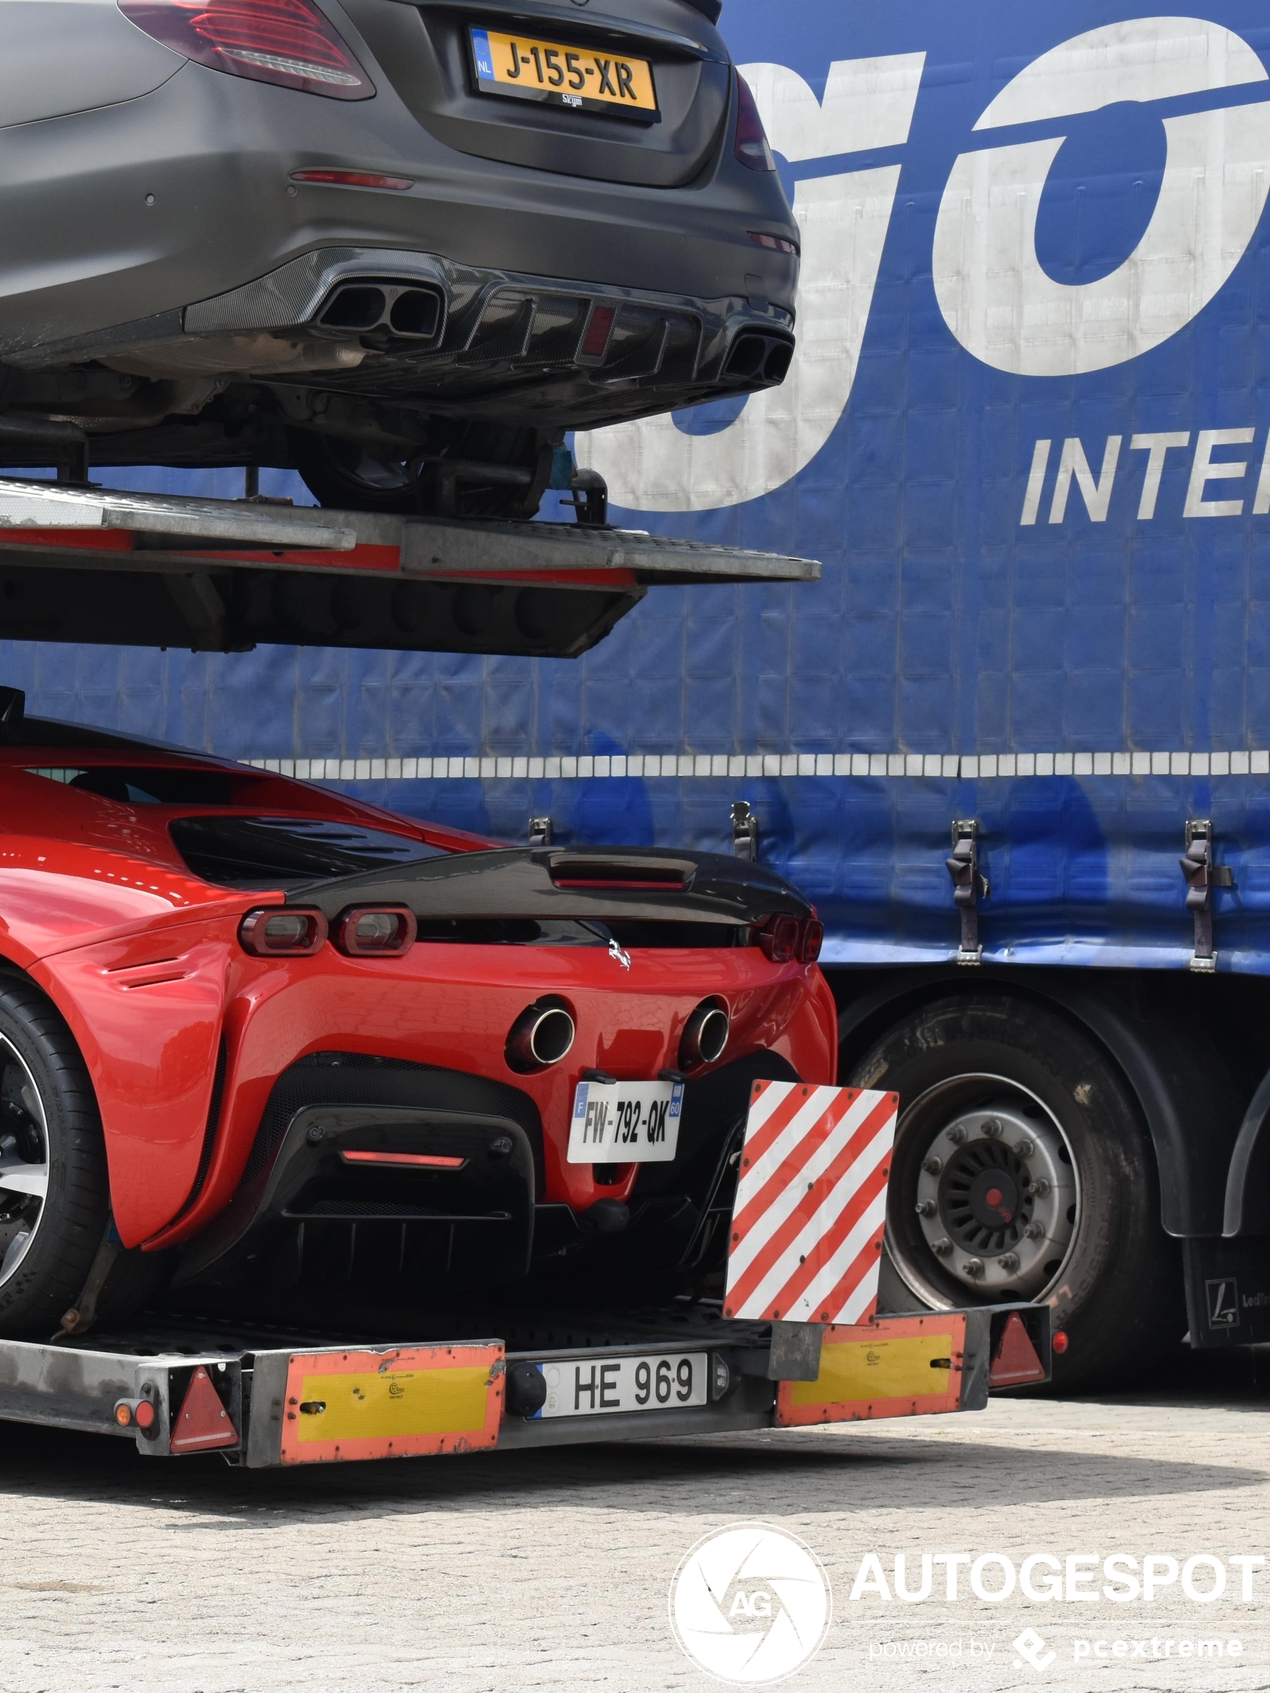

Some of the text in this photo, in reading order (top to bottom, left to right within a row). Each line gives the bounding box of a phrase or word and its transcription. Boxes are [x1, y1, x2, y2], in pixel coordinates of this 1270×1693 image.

[477, 60, 492, 74] NL
[506, 41, 637, 100] J-155-XR
[1020, 426, 1270, 526] INTE
[577, 1101, 584, 1114] F
[583, 1100, 670, 1146] FW-792-QK
[670, 1102, 680, 1115] 60
[574, 1358, 692, 1410] HE 969
